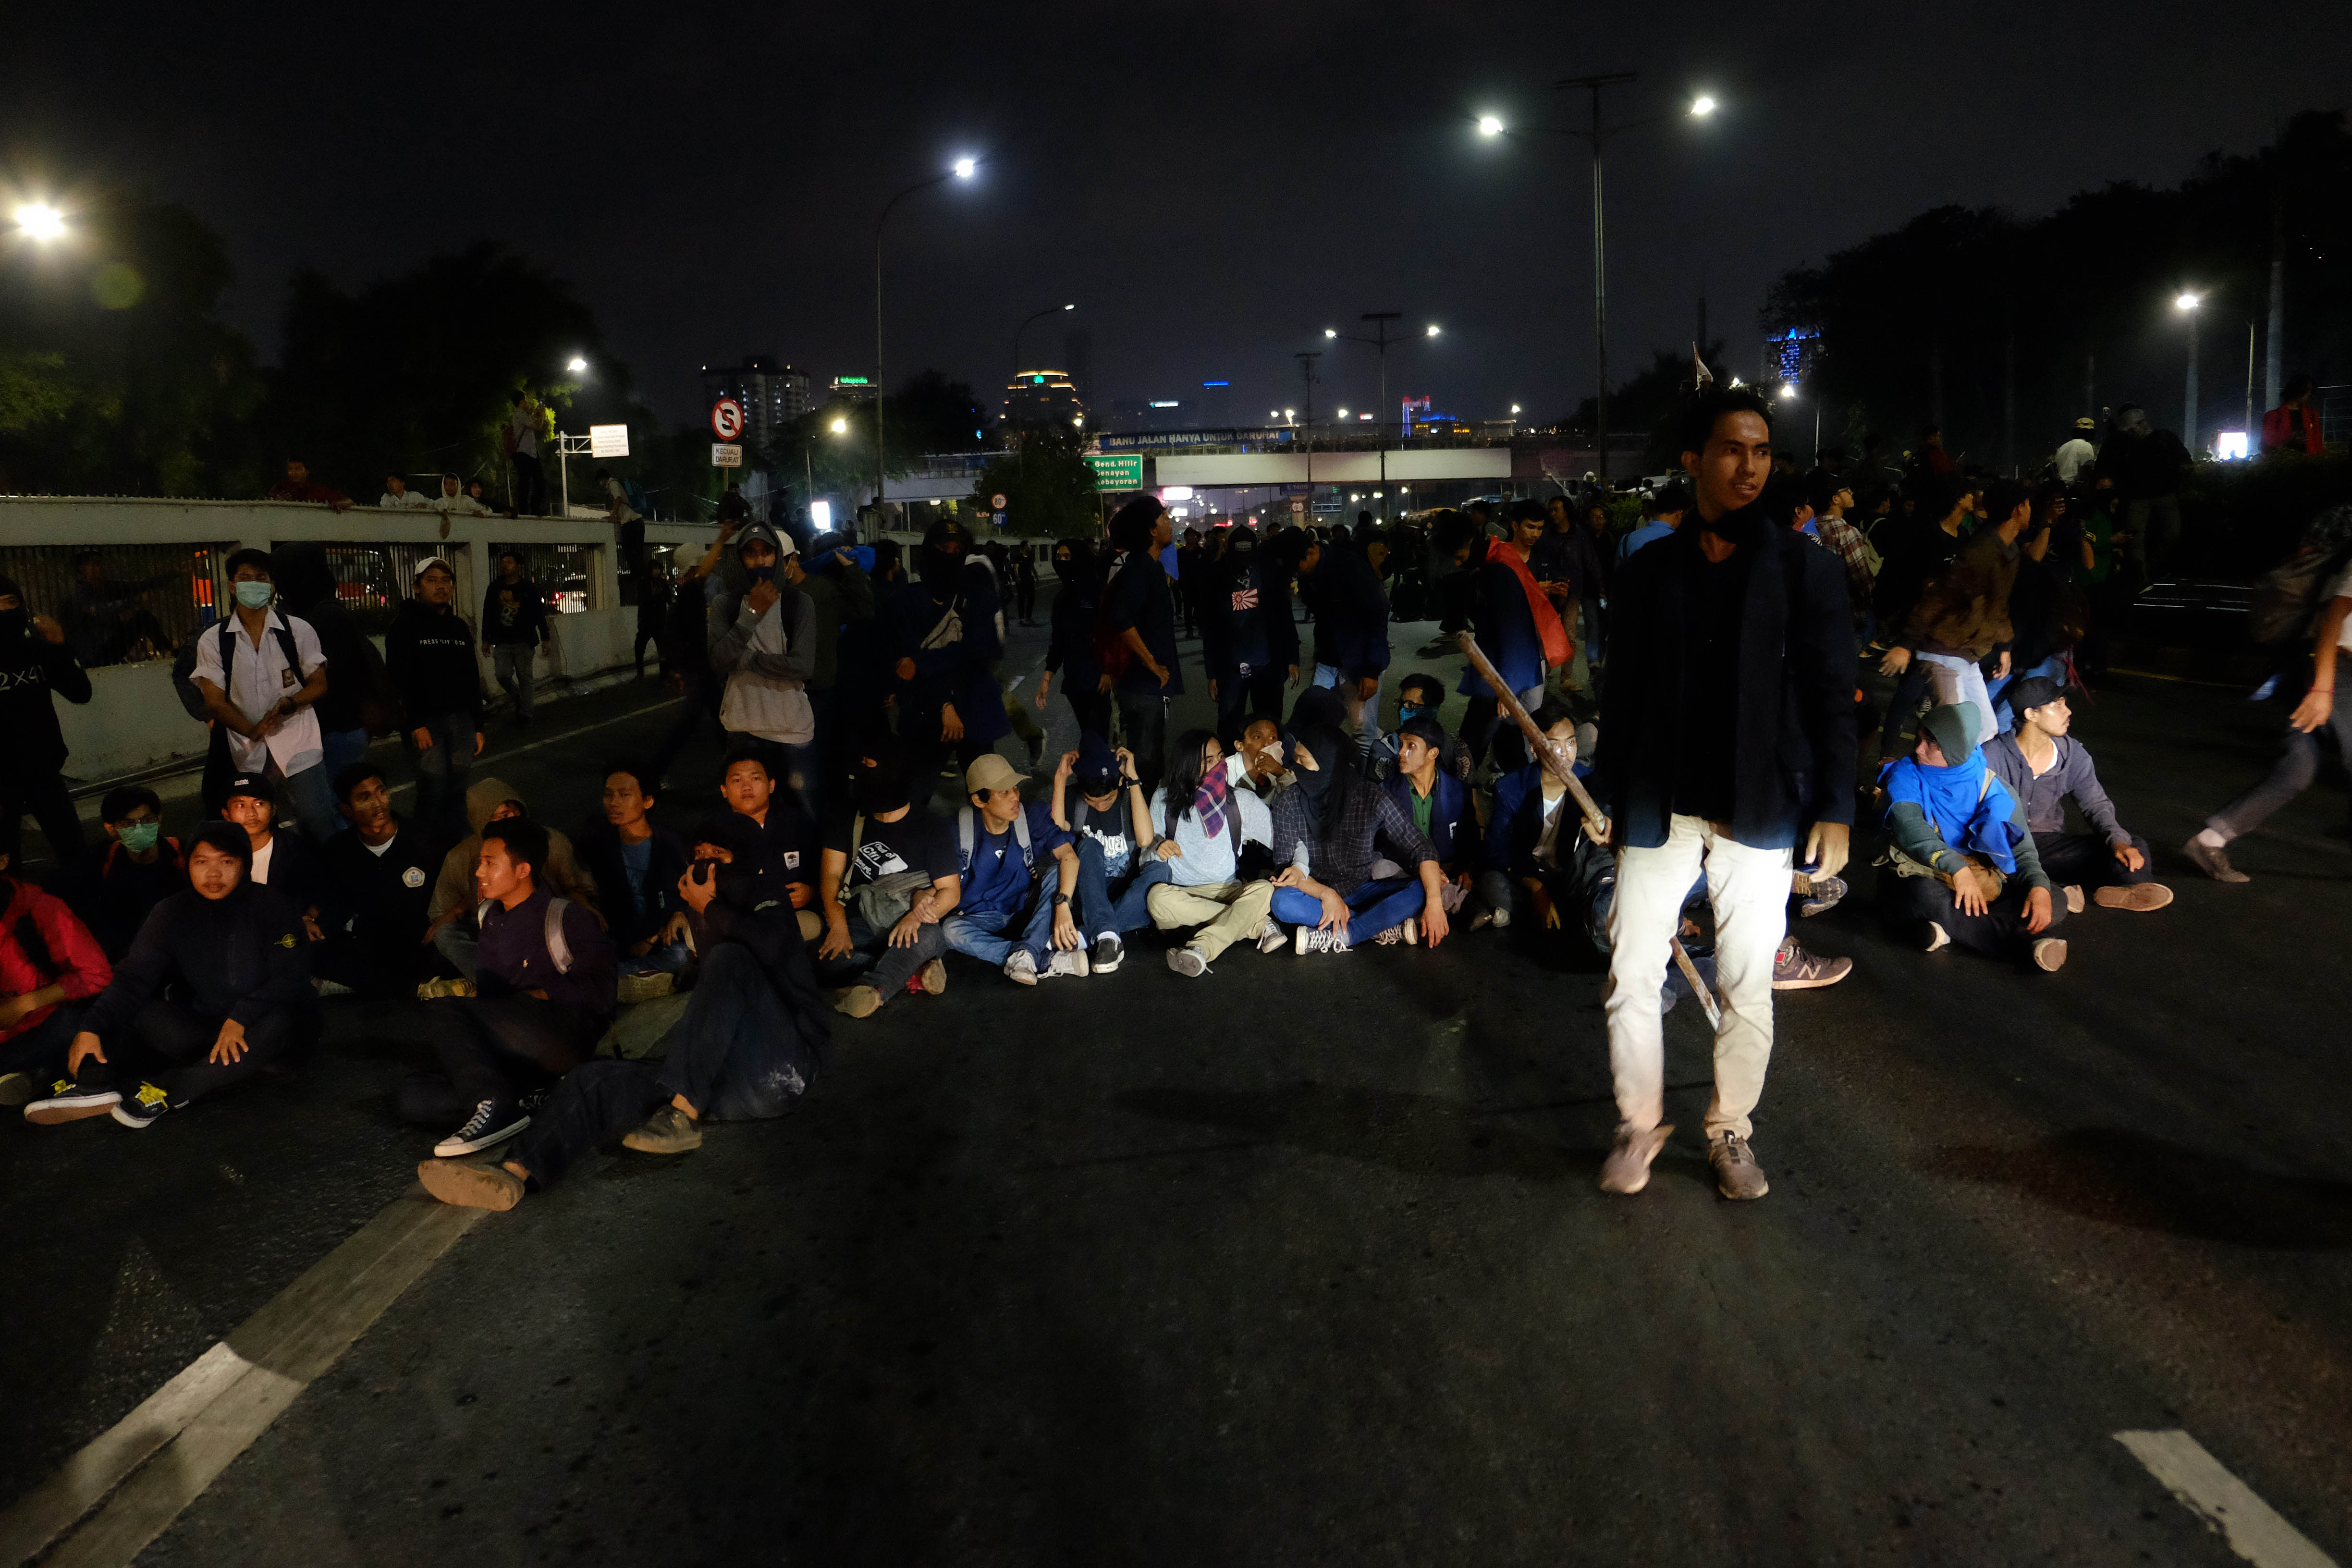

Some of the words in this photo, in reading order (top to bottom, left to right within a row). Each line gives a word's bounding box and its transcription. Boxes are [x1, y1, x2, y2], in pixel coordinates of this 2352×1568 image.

[1109, 437, 1135, 446] BAHU
[1137, 435, 1167, 445] JALAN
[1168, 433, 1201, 443] HANYA
[1202, 433, 1235, 442] UNTUK
[993, 514, 1002, 524] 60
[1797, 963, 1822, 980] N
